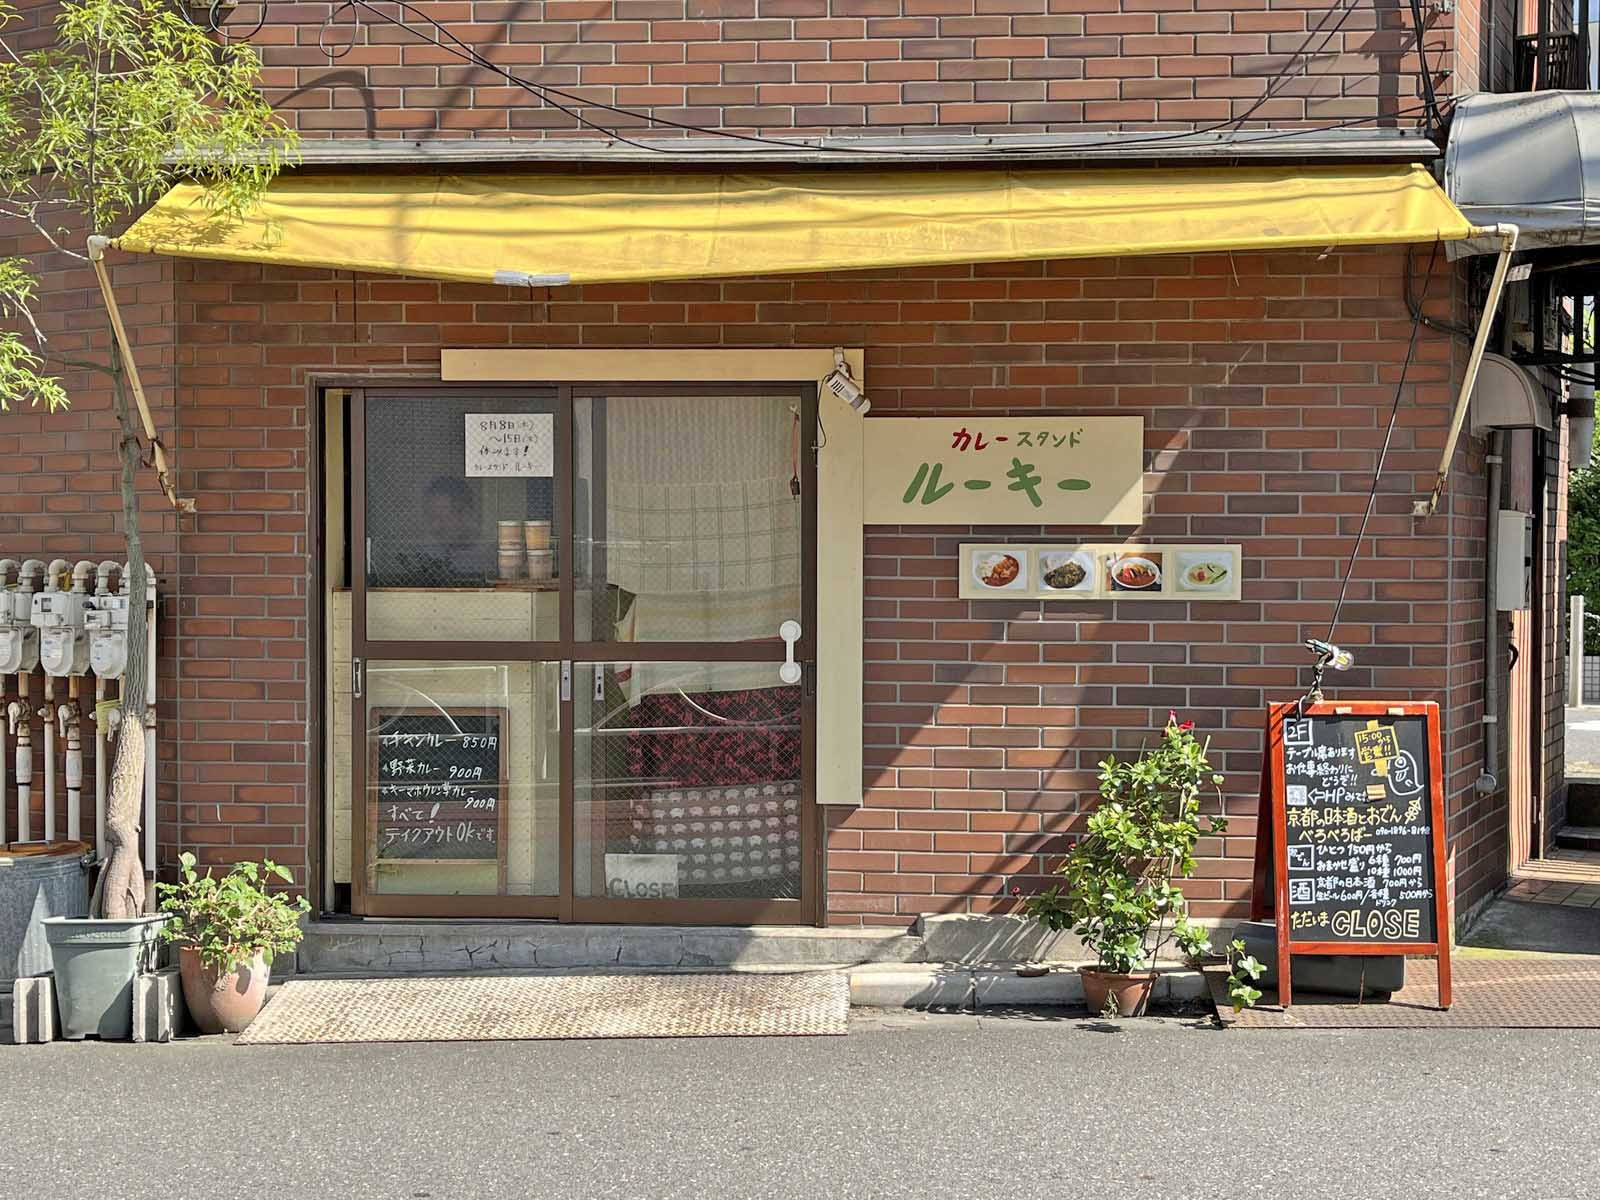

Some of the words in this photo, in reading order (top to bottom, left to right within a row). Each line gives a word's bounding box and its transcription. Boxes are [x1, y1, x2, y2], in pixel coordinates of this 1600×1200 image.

[902, 457, 1091, 507] ルーキー
[1287, 724, 1307, 741] 2F
[462, 736, 498, 750] 850円
[1286, 745, 1355, 761] テーブル席あります
[389, 758, 440, 776] 野菜カレー
[449, 765, 482, 780] 900円
[1286, 761, 1354, 778] お仕事終わりに
[464, 796, 496, 811] 900円
[1287, 804, 1402, 827] 京都の日本酒とおでん
[1394, 853, 1422, 866] 700円
[1393, 866, 1422, 877] 1000円
[1292, 882, 1311, 900] 酒
[1290, 911, 1330, 930] ただいま
[1331, 909, 1420, 939] CLOSE
